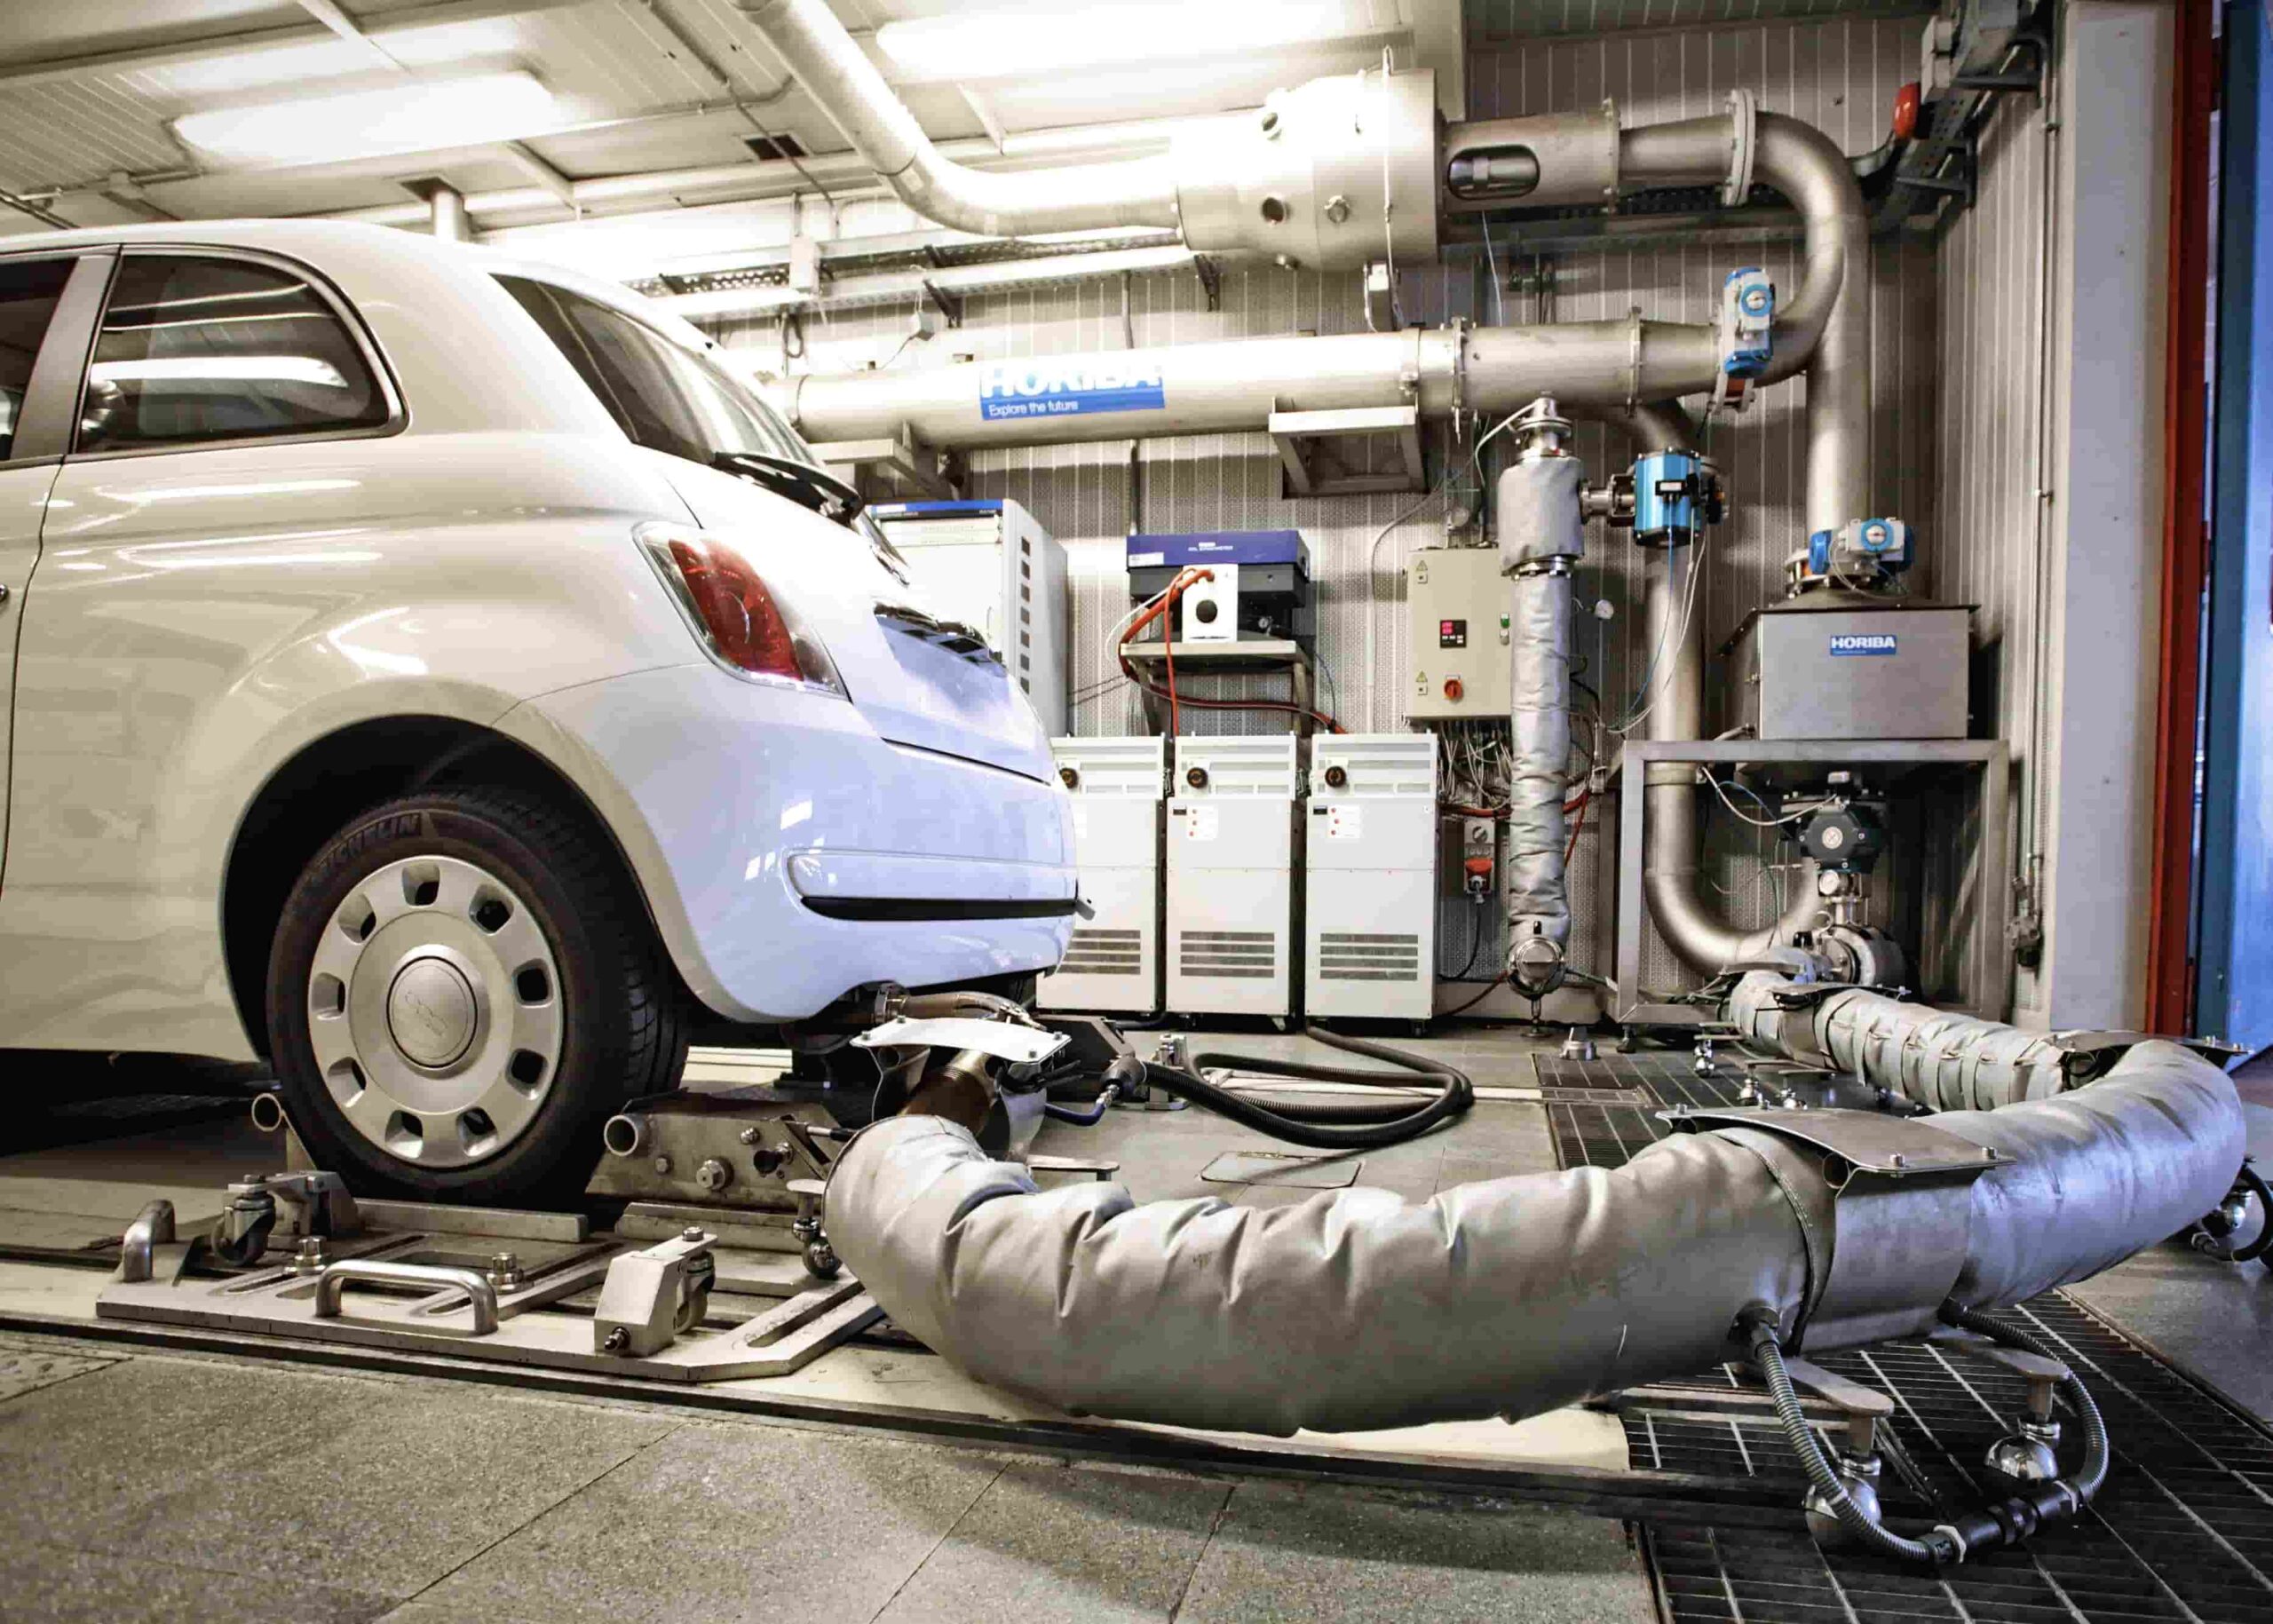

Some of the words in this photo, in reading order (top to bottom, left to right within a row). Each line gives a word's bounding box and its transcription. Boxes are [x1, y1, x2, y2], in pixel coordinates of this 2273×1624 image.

[989, 404, 1027, 416] Explore
[1028, 401, 1047, 414] the
[1048, 400, 1079, 413] future
[1832, 637, 1896, 648] HORIBA
